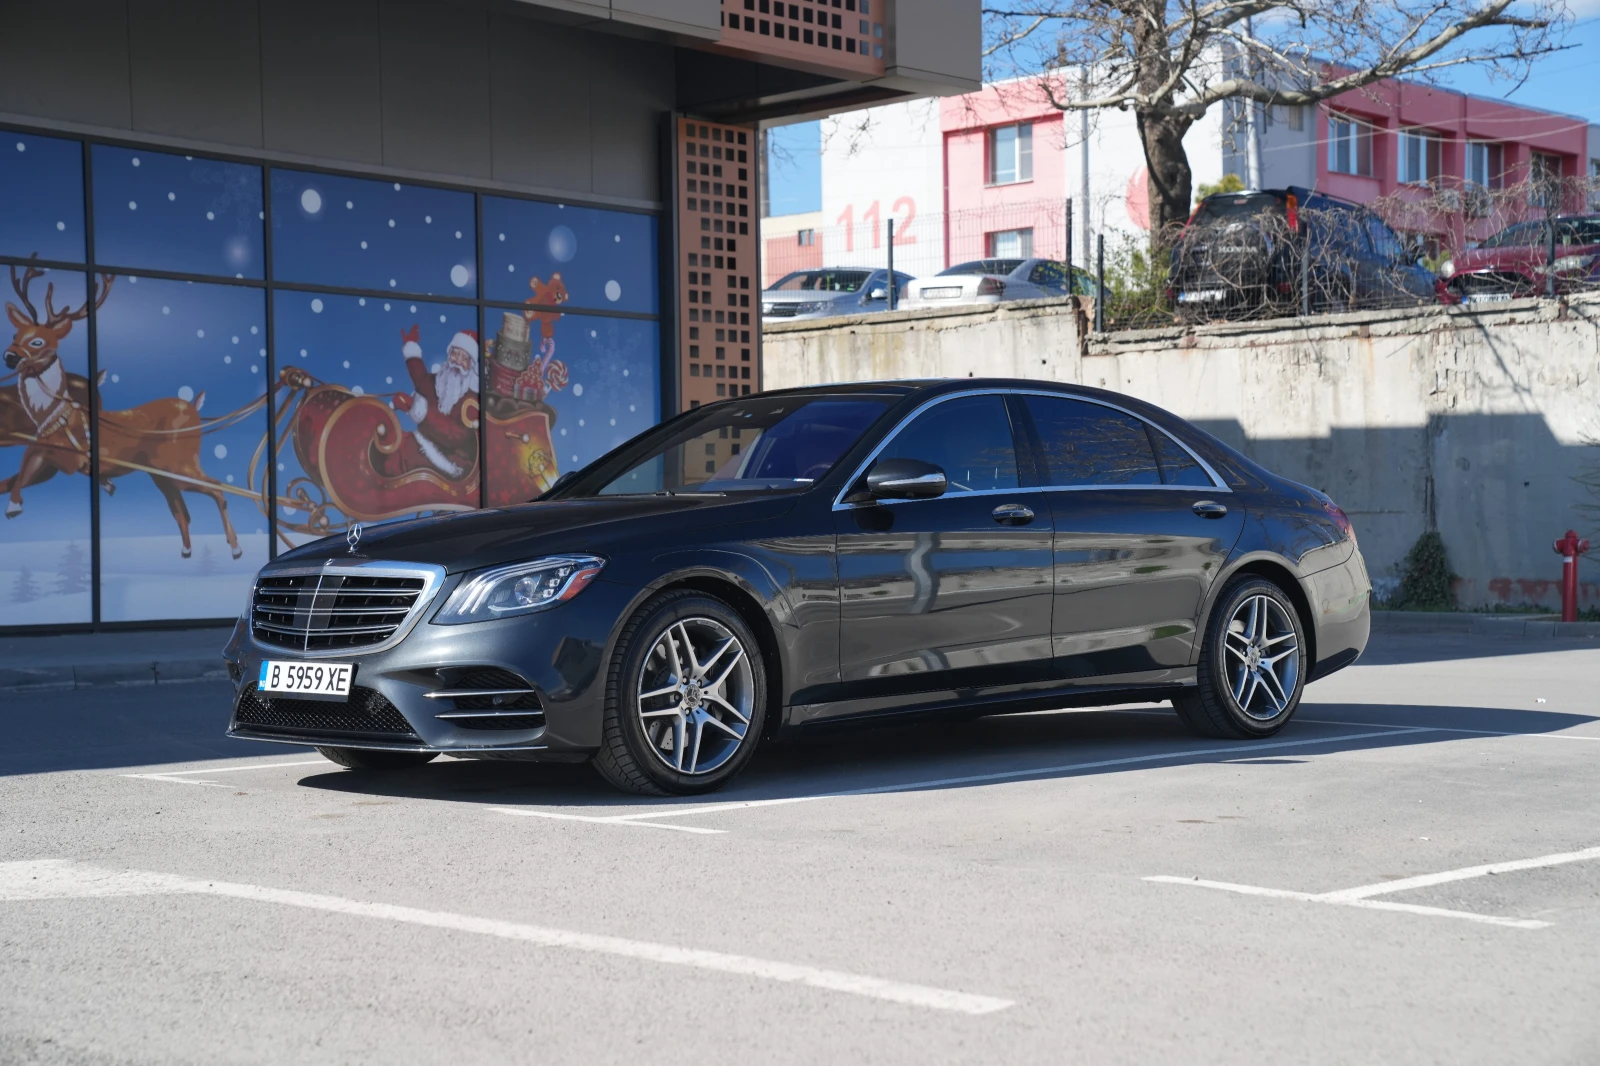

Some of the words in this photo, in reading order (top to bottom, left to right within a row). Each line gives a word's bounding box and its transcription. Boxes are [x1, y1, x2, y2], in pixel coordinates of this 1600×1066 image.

[836, 196, 916, 252] 112
[271, 665, 281, 689] B
[286, 666, 324, 690] 5959
[325, 667, 349, 692] XE
